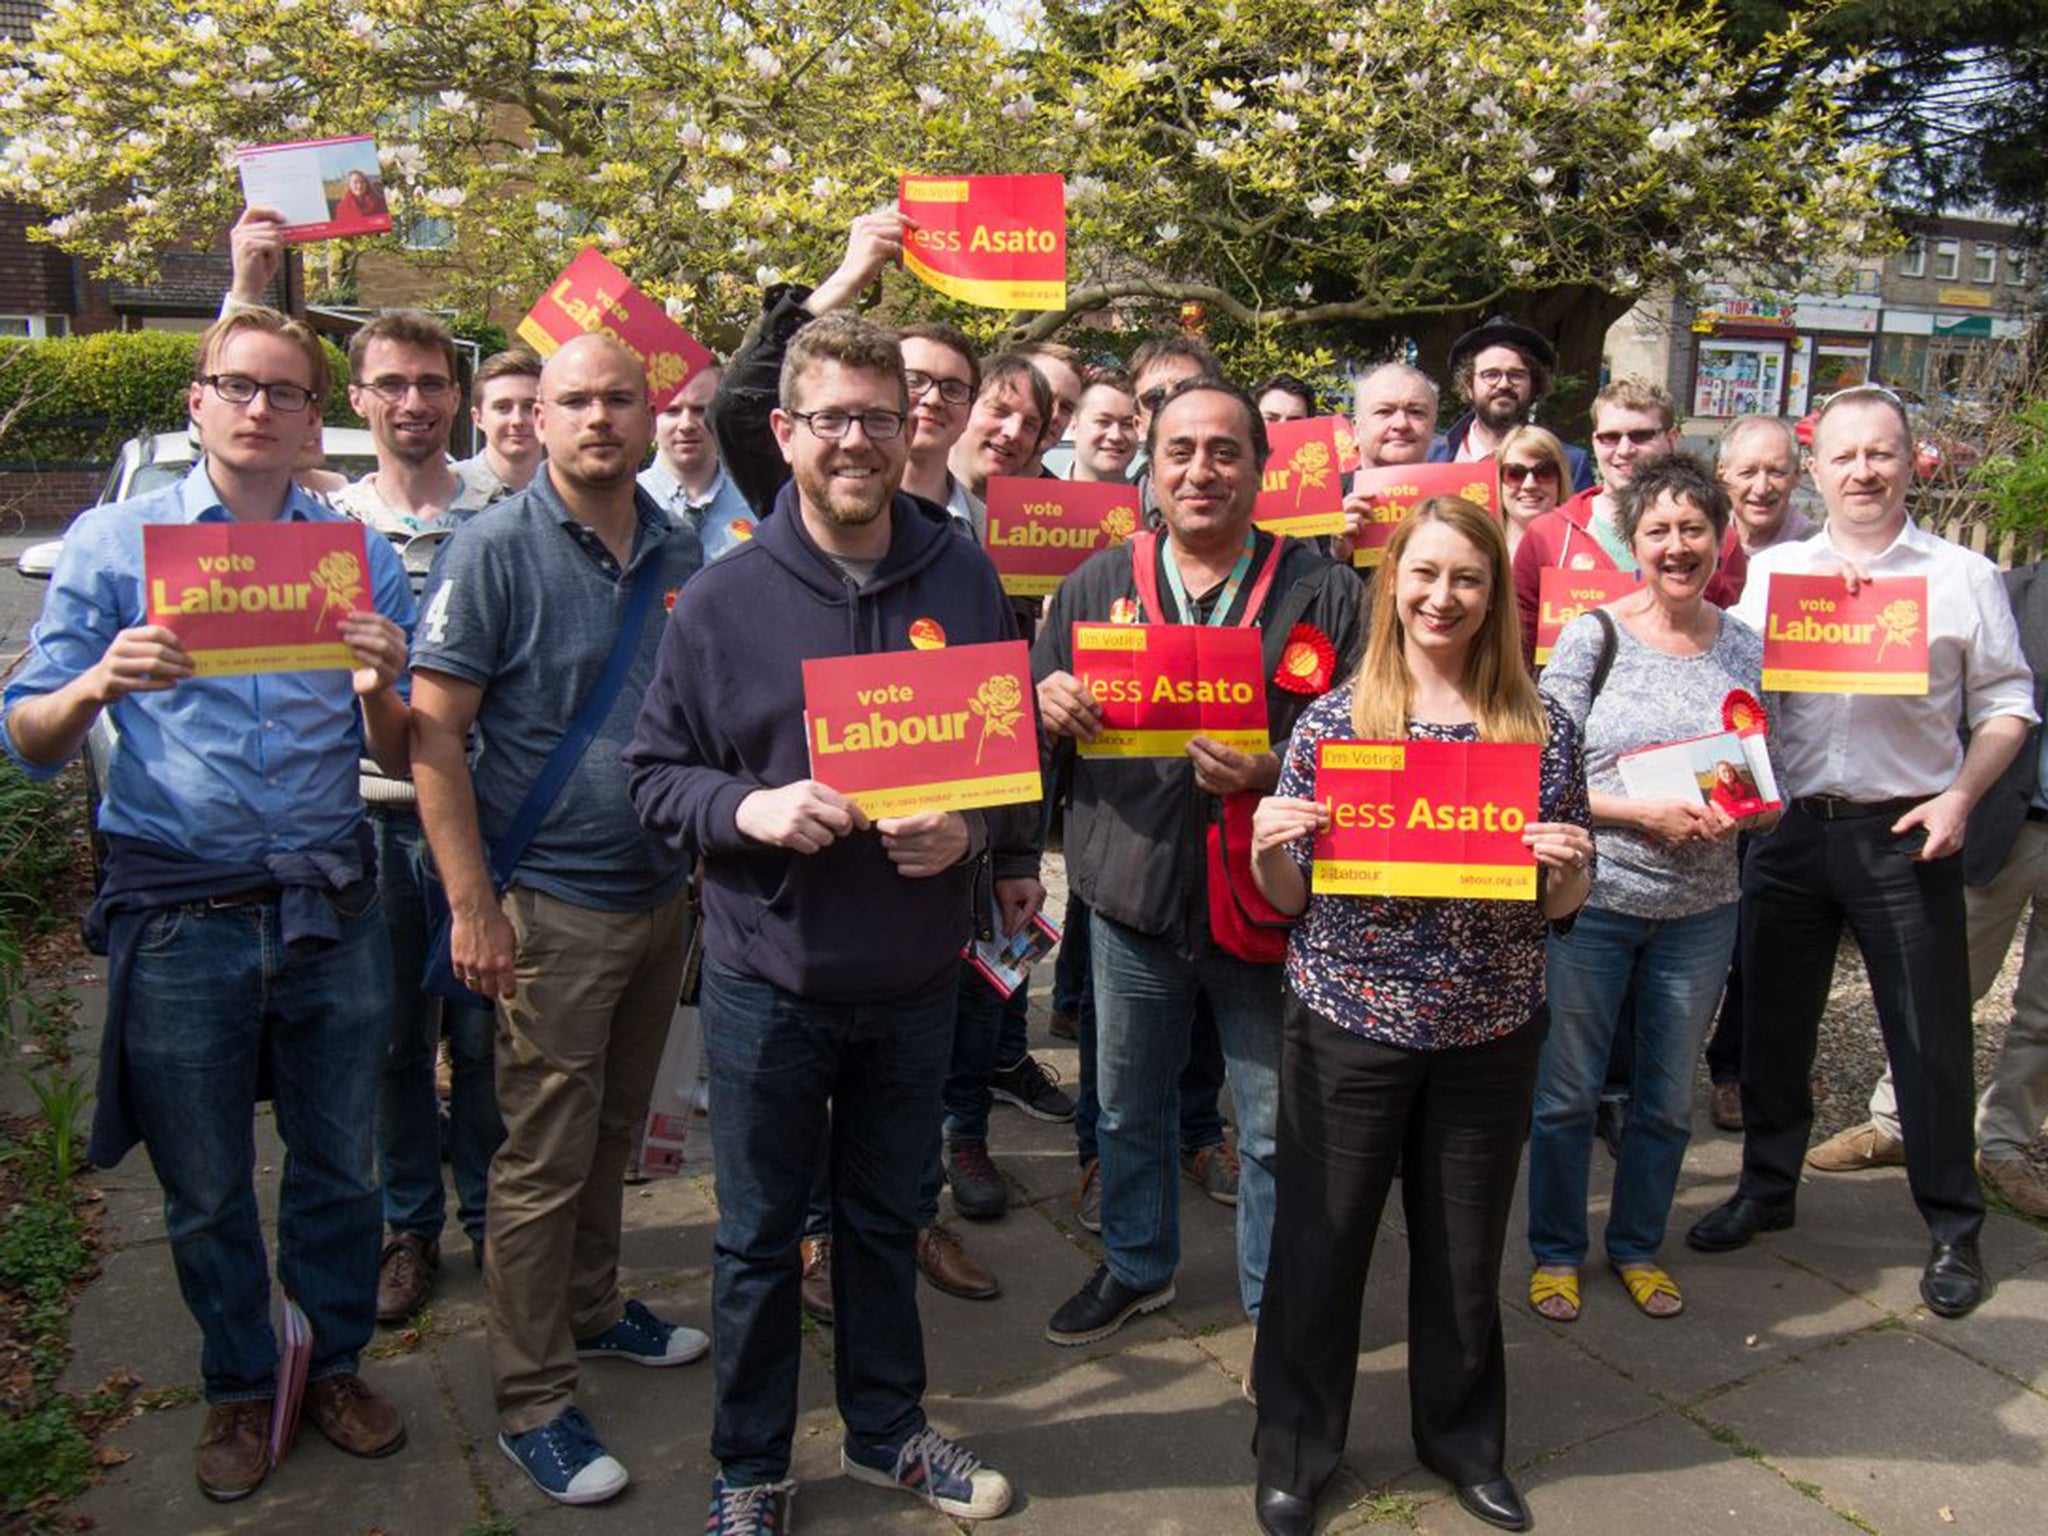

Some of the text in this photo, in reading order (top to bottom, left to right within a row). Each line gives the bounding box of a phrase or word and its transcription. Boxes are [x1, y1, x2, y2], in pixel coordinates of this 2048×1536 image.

[969, 225, 1056, 253] Asato
[596, 288, 629, 322] vote
[1383, 484, 1418, 497] vote
[1023, 502, 1063, 516] vote
[989, 519, 1100, 548] Labour
[197, 553, 255, 573] vote
[152, 578, 312, 615] Labour
[1570, 588, 1606, 600] vote
[1799, 598, 1836, 612] vote
[426, 579, 453, 643] 4
[1769, 613, 1875, 644] Labour
[857, 684, 914, 706] vote
[1152, 675, 1253, 704] Asato
[815, 711, 969, 754] Labour
[1352, 750, 1402, 770] Voting
[1406, 797, 1524, 832] Asato
[1334, 868, 1382, 881] Labour
